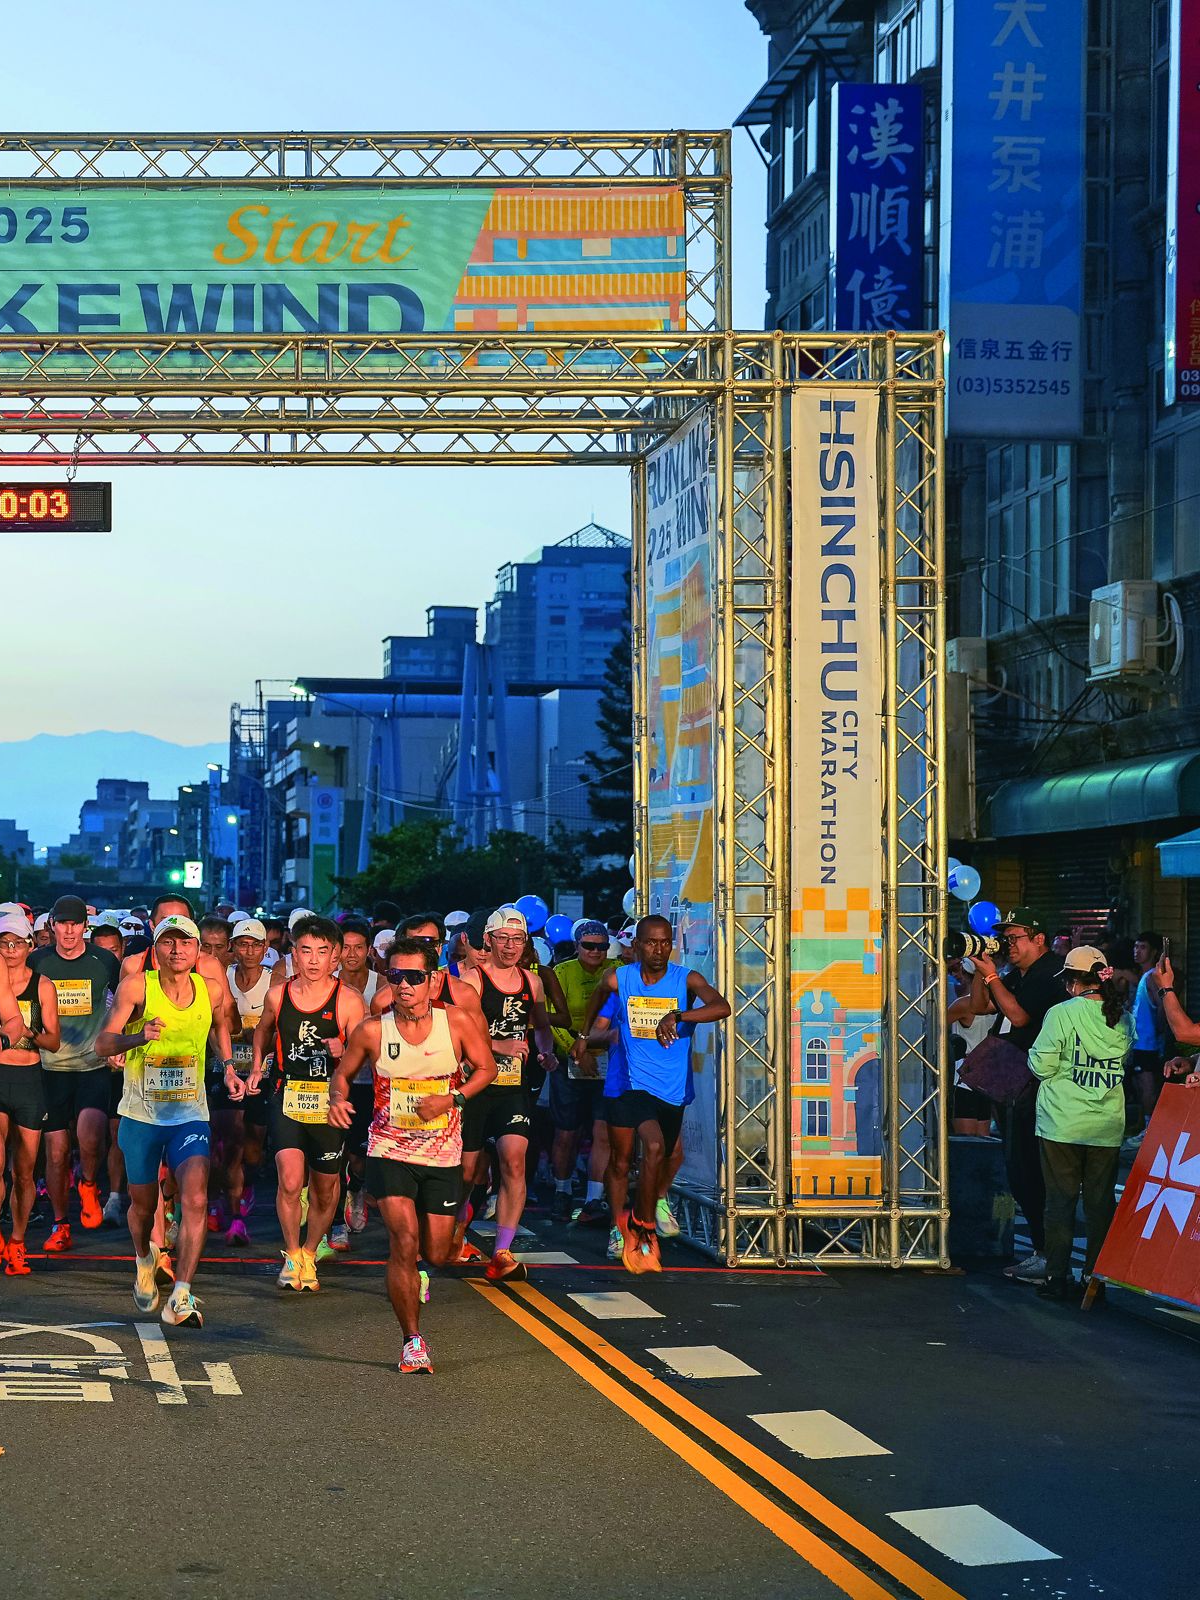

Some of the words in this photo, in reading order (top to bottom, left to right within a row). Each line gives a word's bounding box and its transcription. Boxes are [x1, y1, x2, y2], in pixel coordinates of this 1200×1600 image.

[213, 204, 413, 265] Start
[956, 338, 1073, 363] 信泉五金行
[956, 377, 1072, 397] (03)5352545
[818, 400, 858, 702] HSINCHU
[842, 710, 858, 781] CITY
[820, 711, 837, 886] MARATHON
[159, 1079, 184, 1087] 11183
[297, 1102, 319, 1110] 10249
